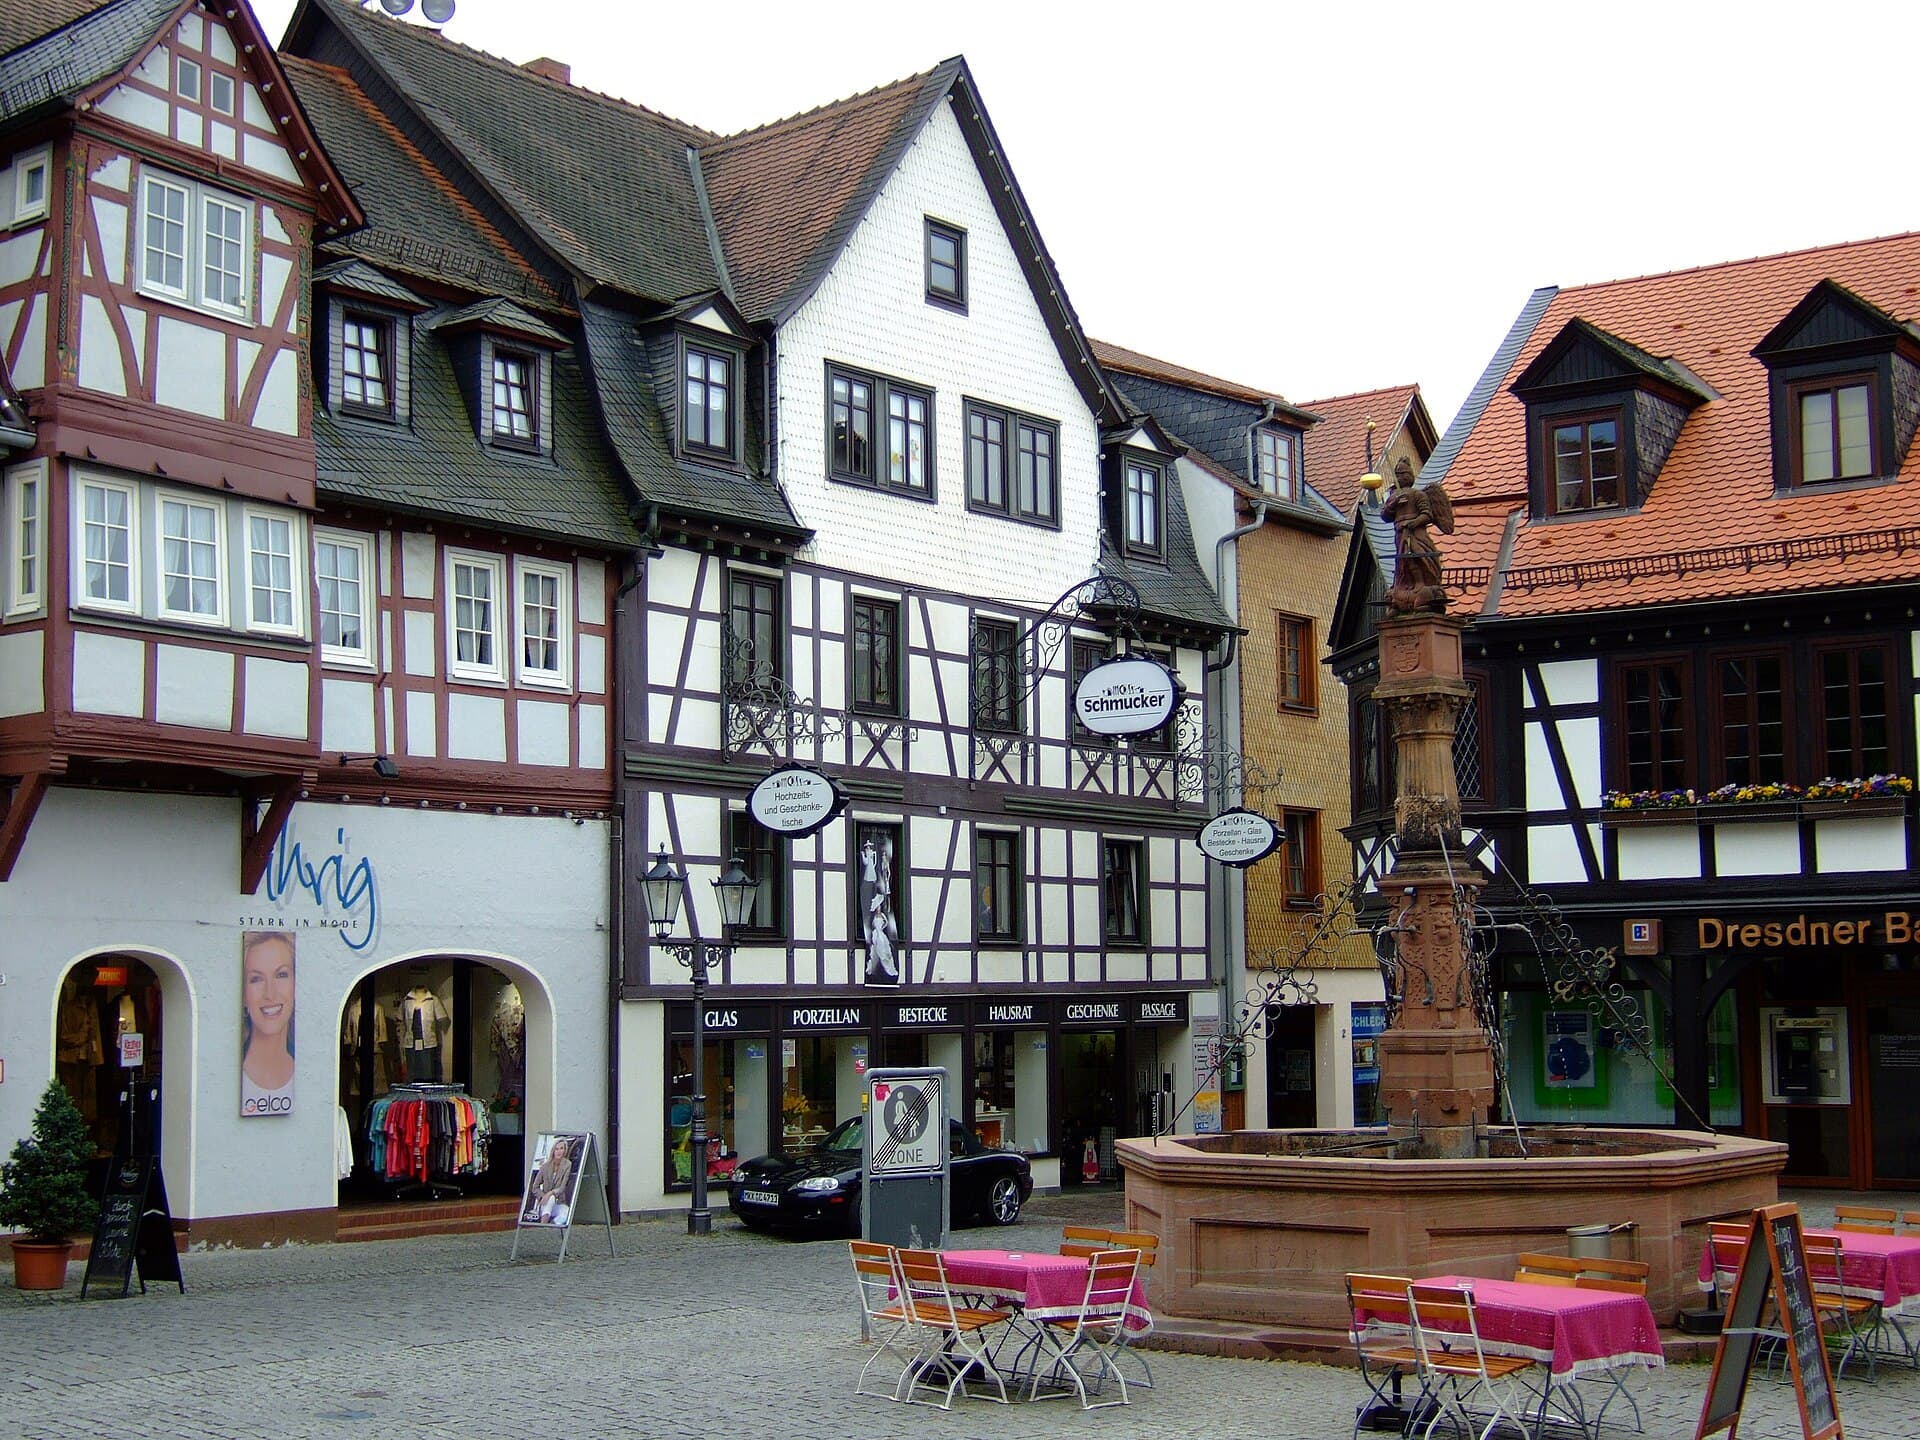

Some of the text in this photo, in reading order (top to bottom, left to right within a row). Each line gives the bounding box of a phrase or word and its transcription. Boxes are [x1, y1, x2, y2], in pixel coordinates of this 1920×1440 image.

[1084, 694, 1165, 712] schmucker
[774, 792, 812, 801] Hochzeits-
[765, 803, 823, 814] und Geschenke-
[1219, 848, 1254, 856] Geschenke
[239, 917, 358, 929] STARK IN MODE
[1698, 914, 1871, 949] Dresdner
[793, 1008, 860, 1025] PORZELLAN
[898, 1006, 948, 1023] BESTECKE
[989, 1005, 1033, 1021] HAUSRAT
[1067, 1003, 1119, 1019] GESCHENKE
[1141, 1003, 1176, 1017] PASSAGE
[705, 1010, 738, 1027] GLAS
[890, 1148, 923, 1164] ZONE
